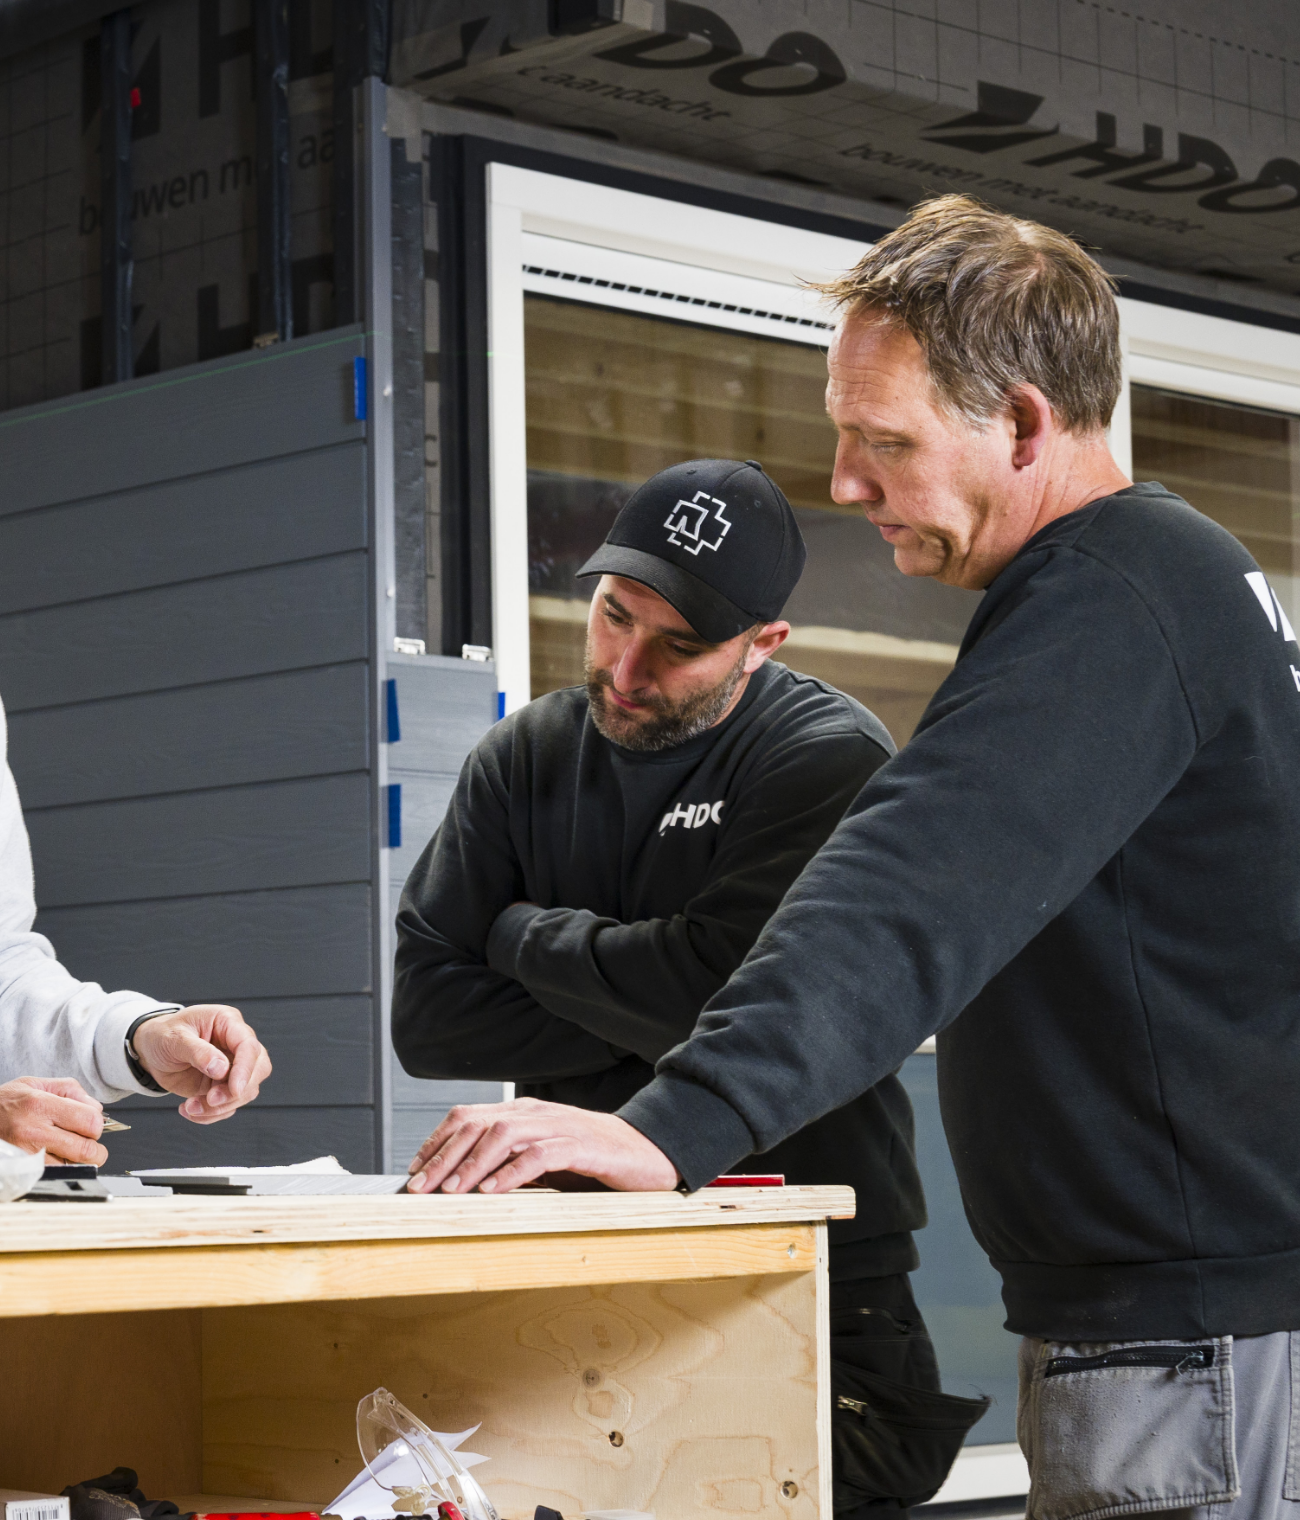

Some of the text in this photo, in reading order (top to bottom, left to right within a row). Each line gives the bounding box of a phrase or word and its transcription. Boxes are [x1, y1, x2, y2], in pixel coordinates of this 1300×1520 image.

[592, 0, 847, 96] DO
[539, 73, 732, 121] aandacht
[79, 168, 209, 236] bwen
[1022, 111, 1300, 213] HDO
